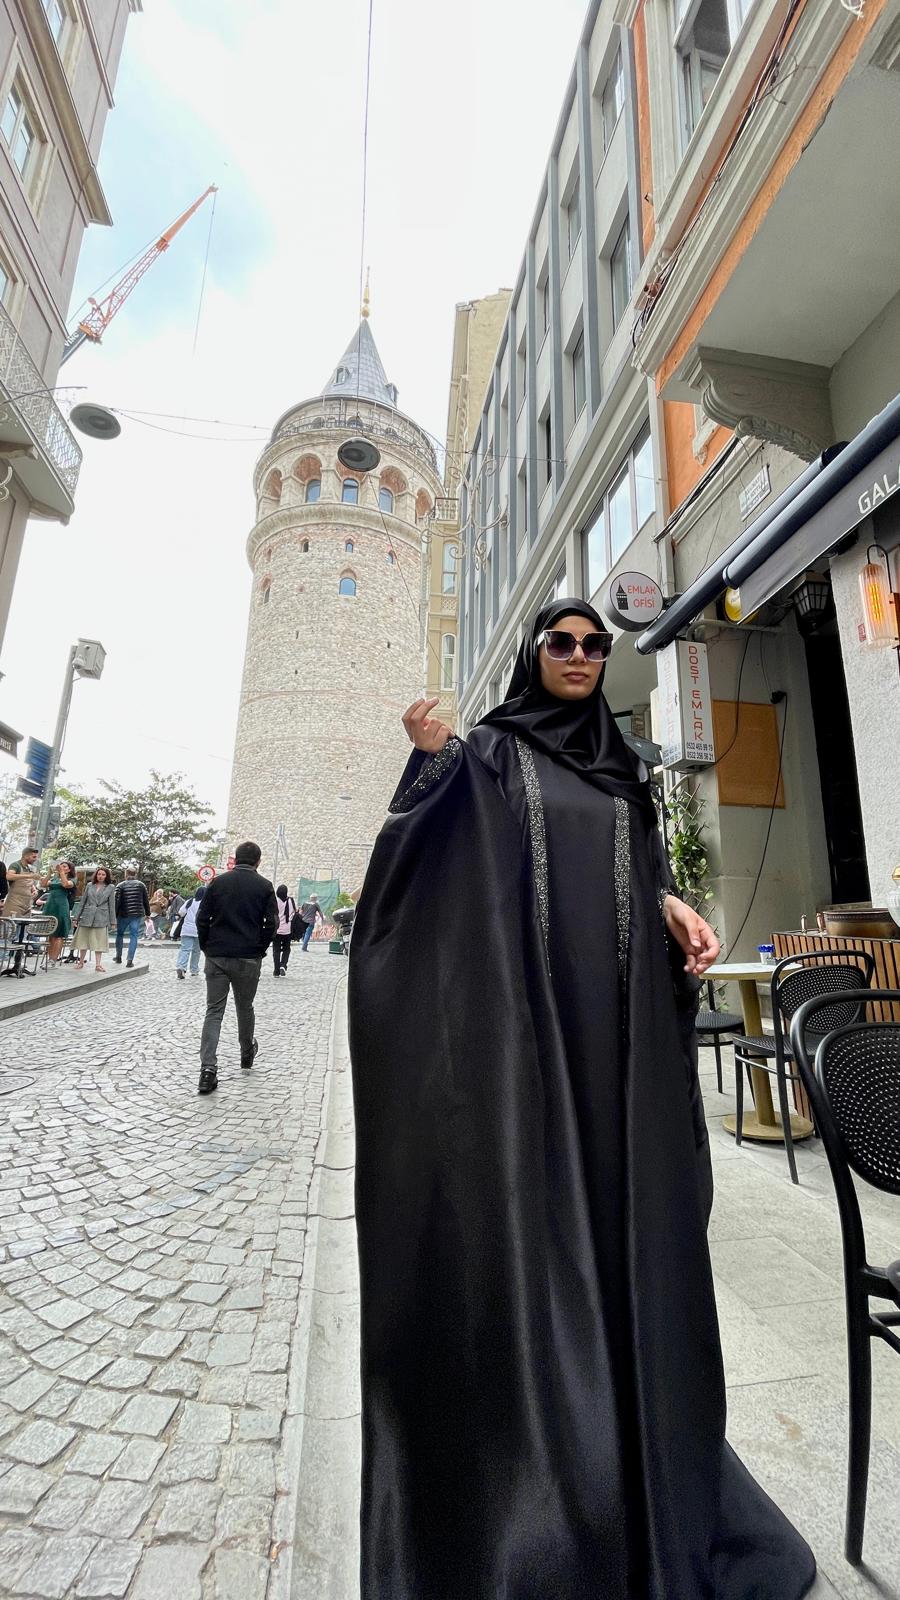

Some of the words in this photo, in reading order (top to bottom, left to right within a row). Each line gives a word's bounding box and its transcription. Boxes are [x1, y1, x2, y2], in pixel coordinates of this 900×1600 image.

[858, 464, 900, 514] GAL
[627, 585, 656, 595] EMLAK
[688, 645, 699, 685] DOST
[691, 690, 704, 741] EMLAK
